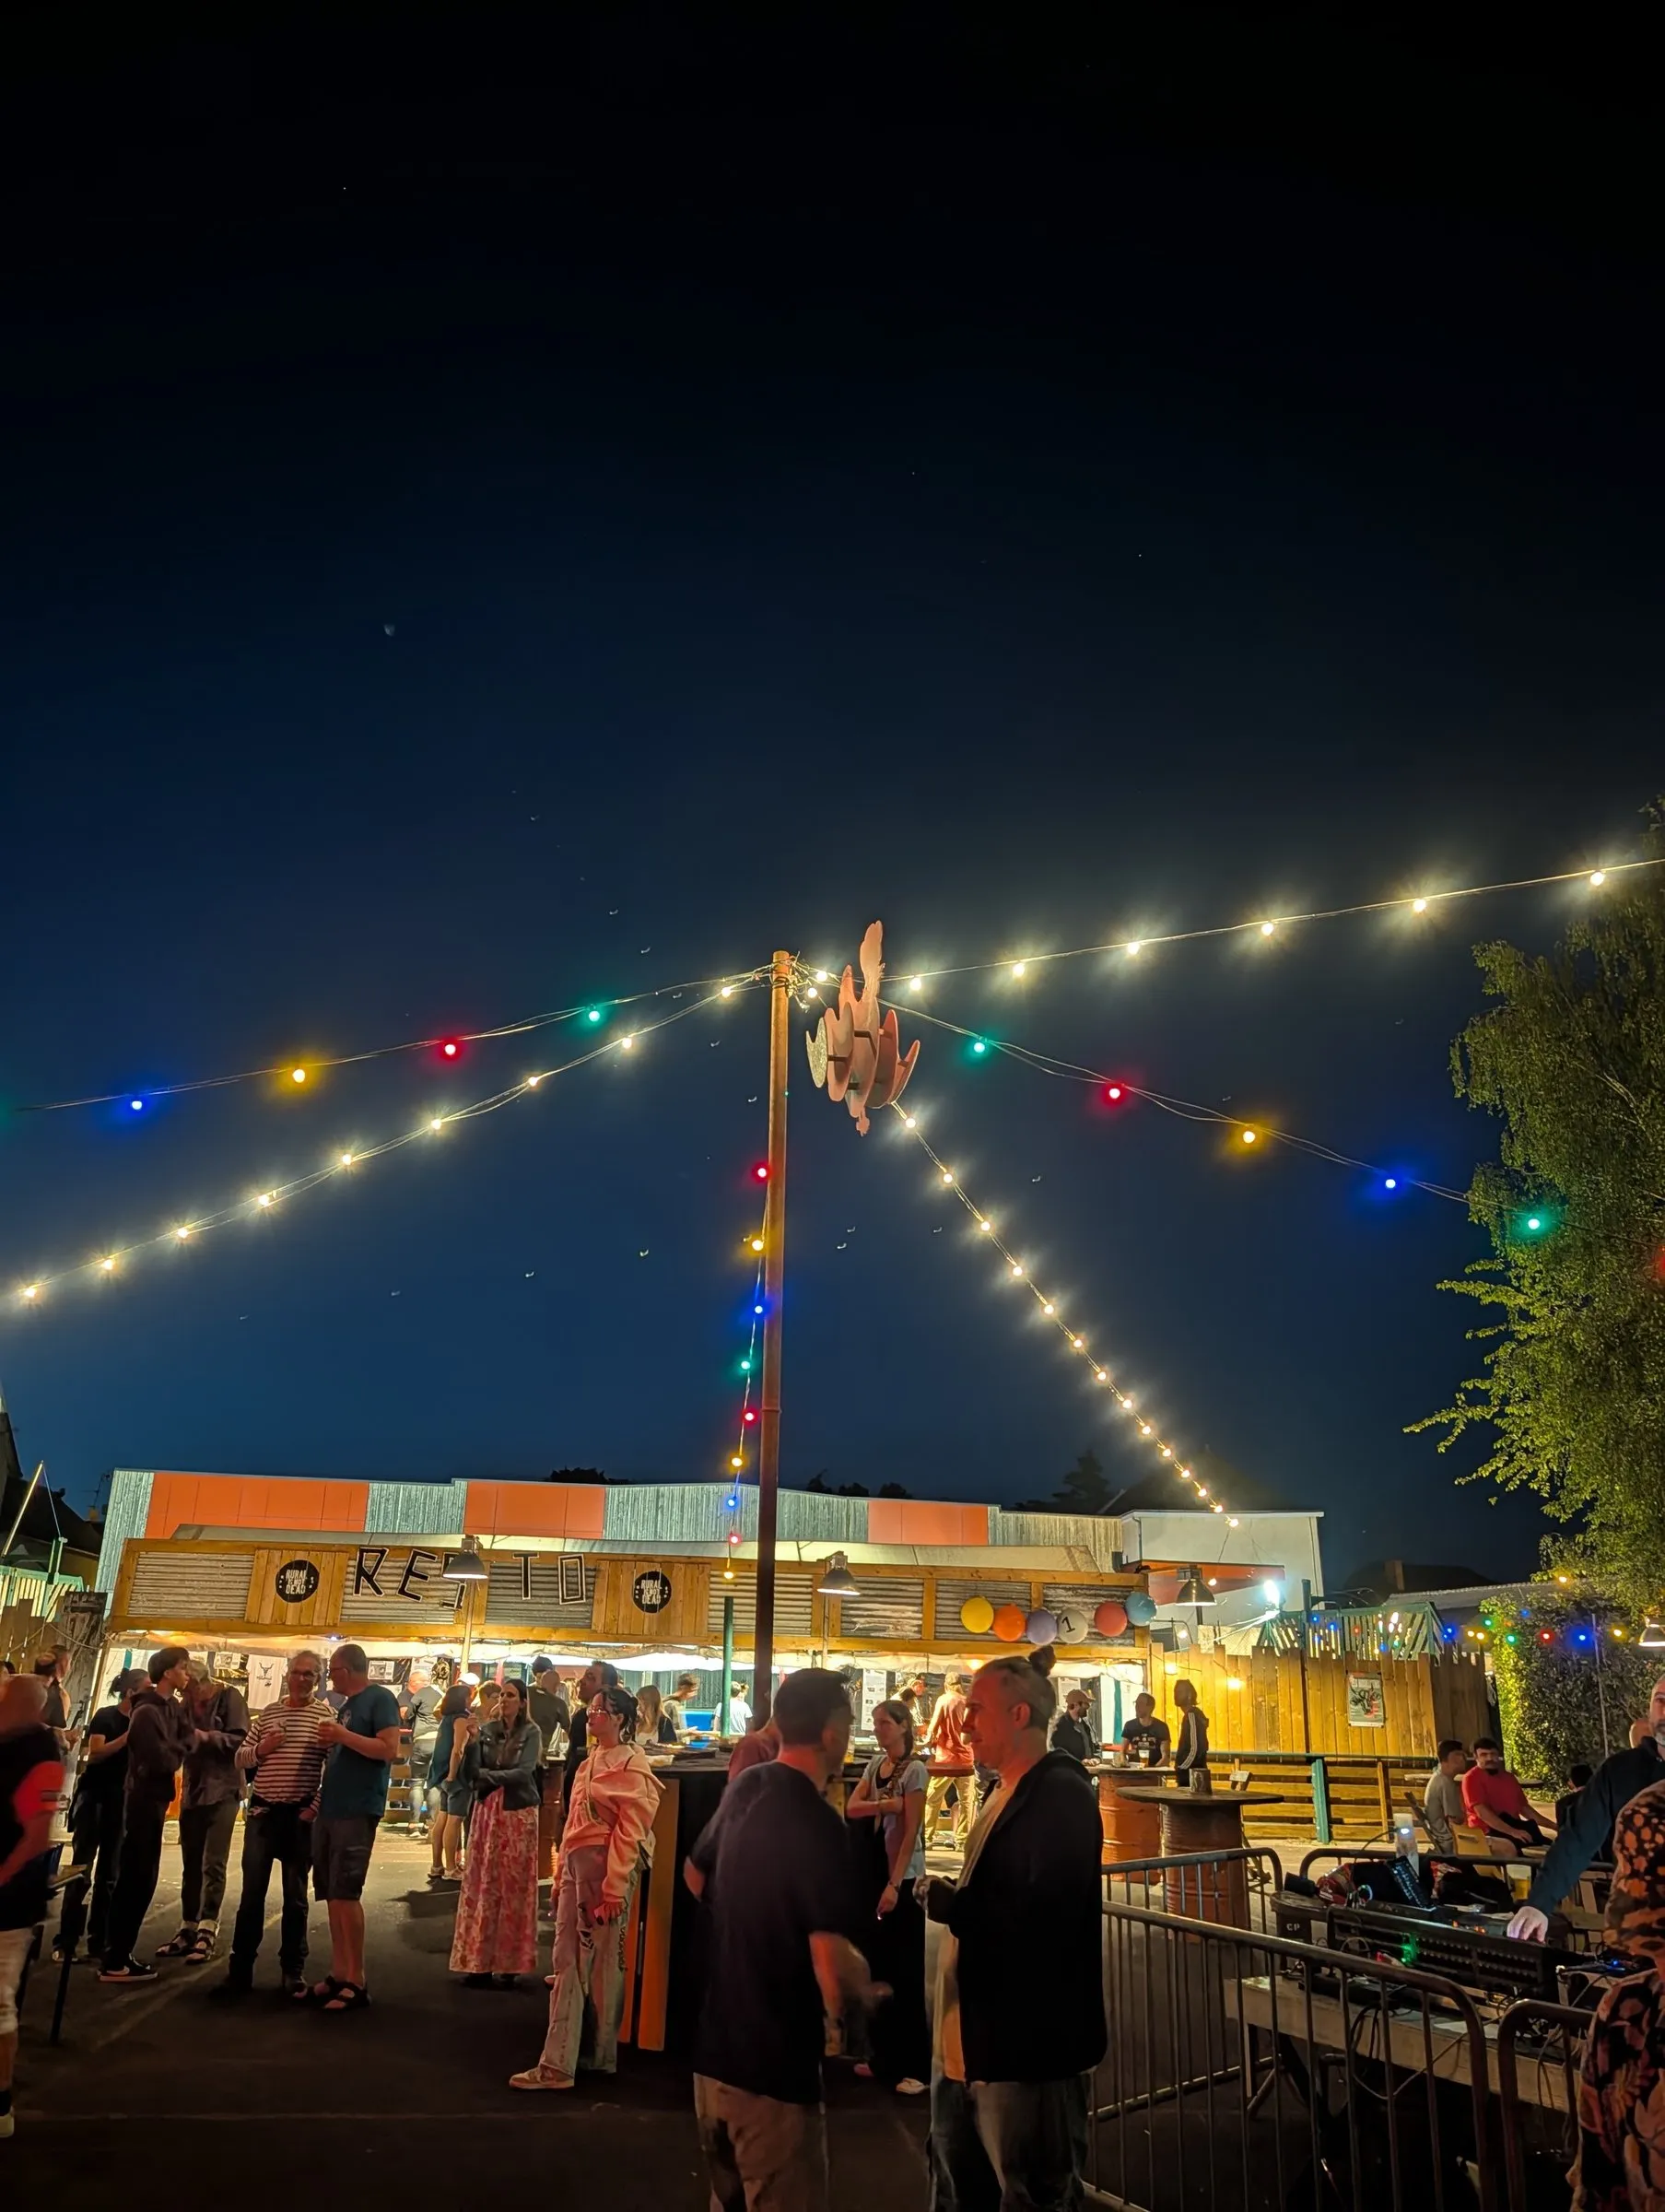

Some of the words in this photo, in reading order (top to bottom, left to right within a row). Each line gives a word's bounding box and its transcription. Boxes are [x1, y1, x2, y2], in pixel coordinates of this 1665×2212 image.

[286, 1570, 308, 1580] RURAL
[286, 1584, 306, 1594] DEAD
[641, 1580, 662, 1589] RURAL
[642, 1594, 662, 1605] DEAD
[1061, 1617, 1075, 1633] 1
